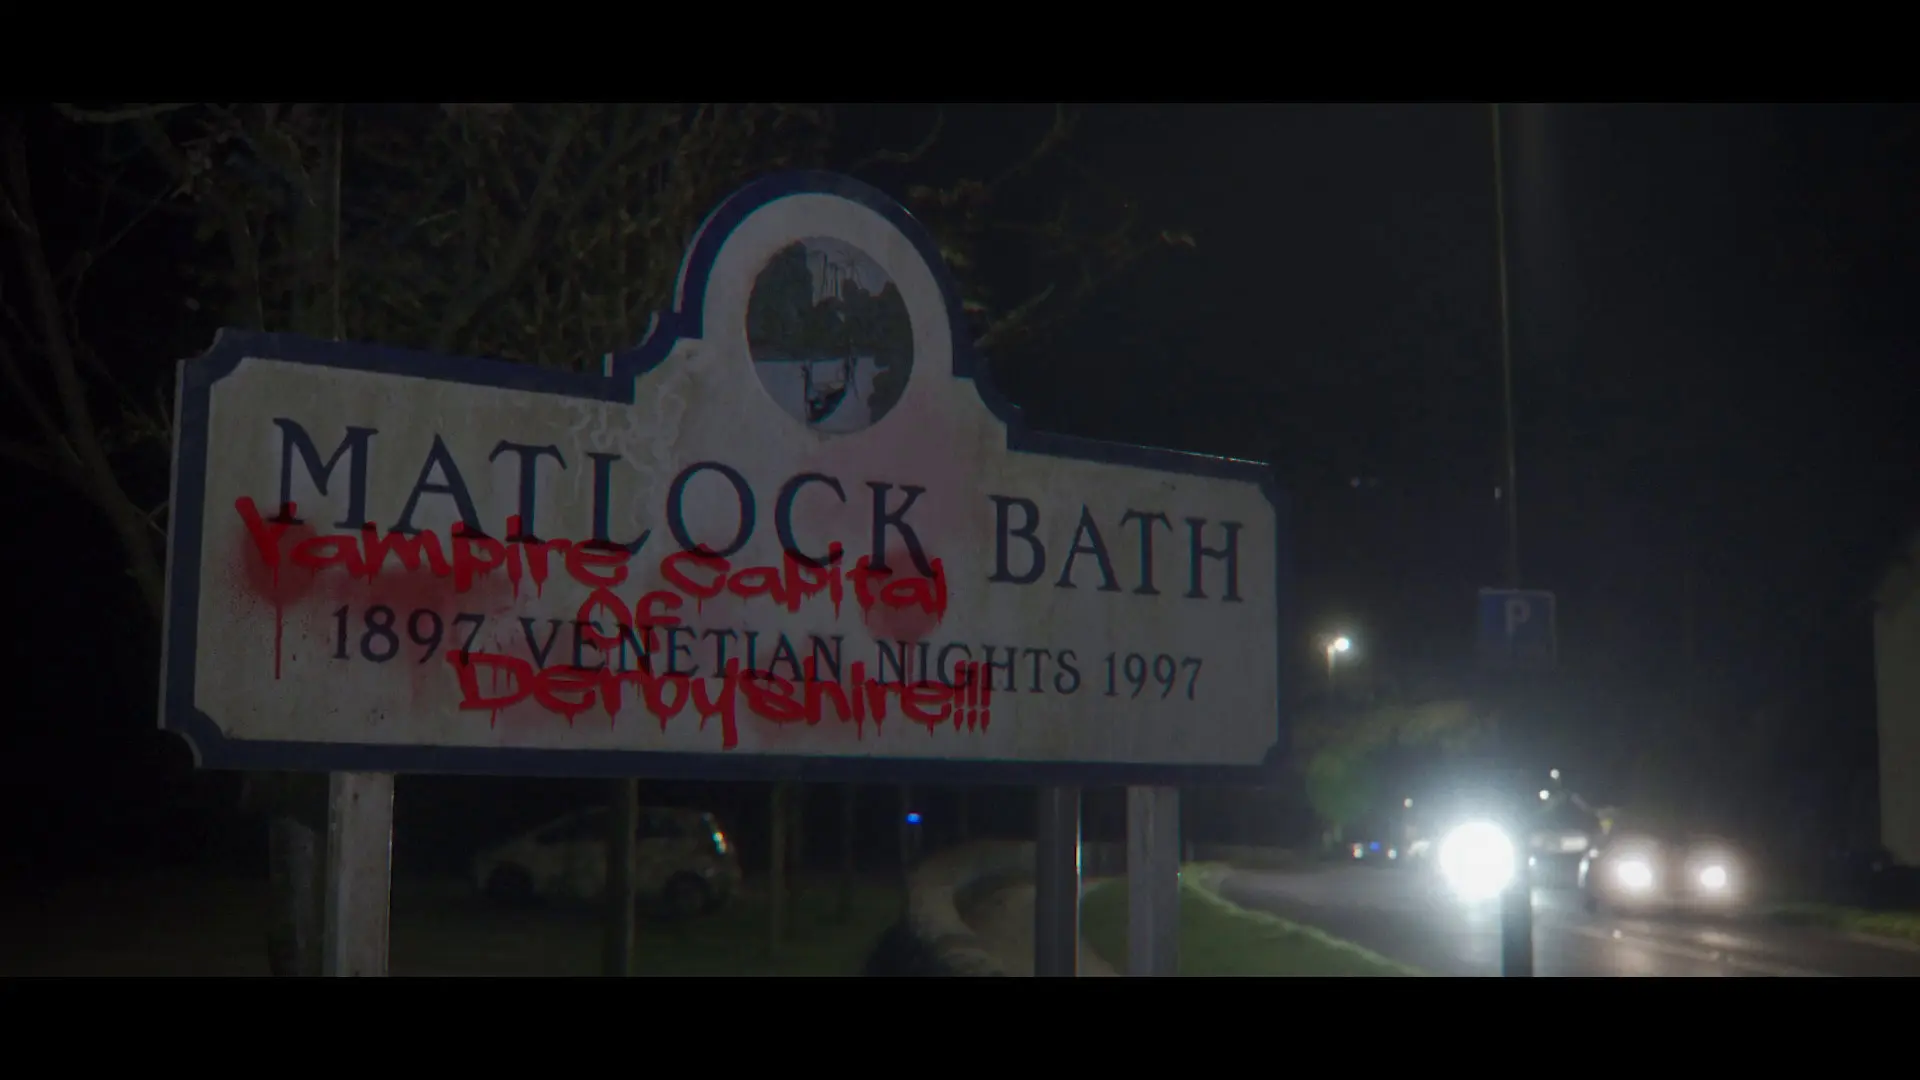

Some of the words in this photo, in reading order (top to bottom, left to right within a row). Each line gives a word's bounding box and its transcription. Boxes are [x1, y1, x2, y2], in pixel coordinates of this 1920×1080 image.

[235, 496, 632, 600] Vampire
[660, 540, 947, 616] Capital
[273, 417, 936, 578] MATLOCK
[987, 494, 1244, 603] BATH
[332, 604, 486, 669] 1897
[518, 616, 844, 686] VENETIAN
[876, 639, 1082, 695] NIGHTS
[1103, 651, 1204, 700] 1997
[578, 586, 684, 654] Of
[1505, 598, 1531, 633] P
[446, 650, 991, 749] Derbyshire!!!
